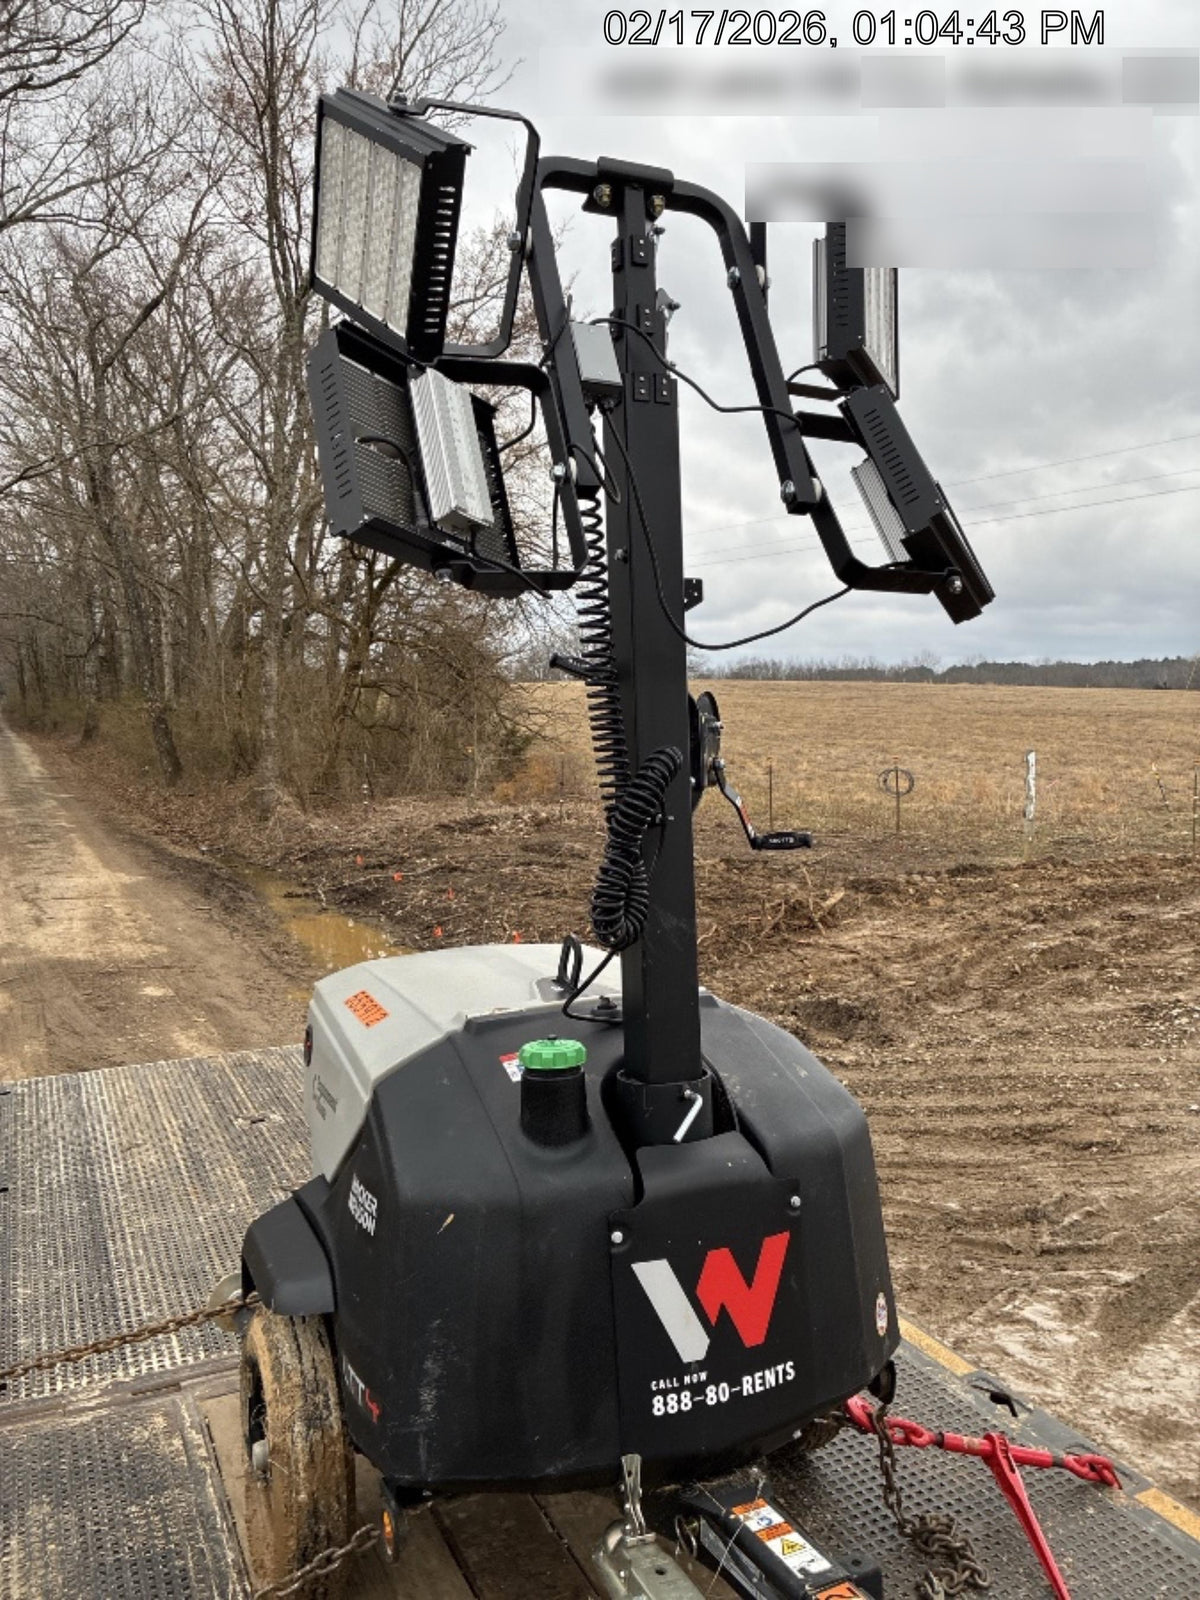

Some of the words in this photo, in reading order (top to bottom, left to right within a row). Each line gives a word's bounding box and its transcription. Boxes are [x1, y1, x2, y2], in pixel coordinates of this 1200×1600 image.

[650, 1377, 681, 1391] CALL
[683, 1371, 708, 1386] NOW
[651, 1360, 796, 1417] 888-80-RENTS
